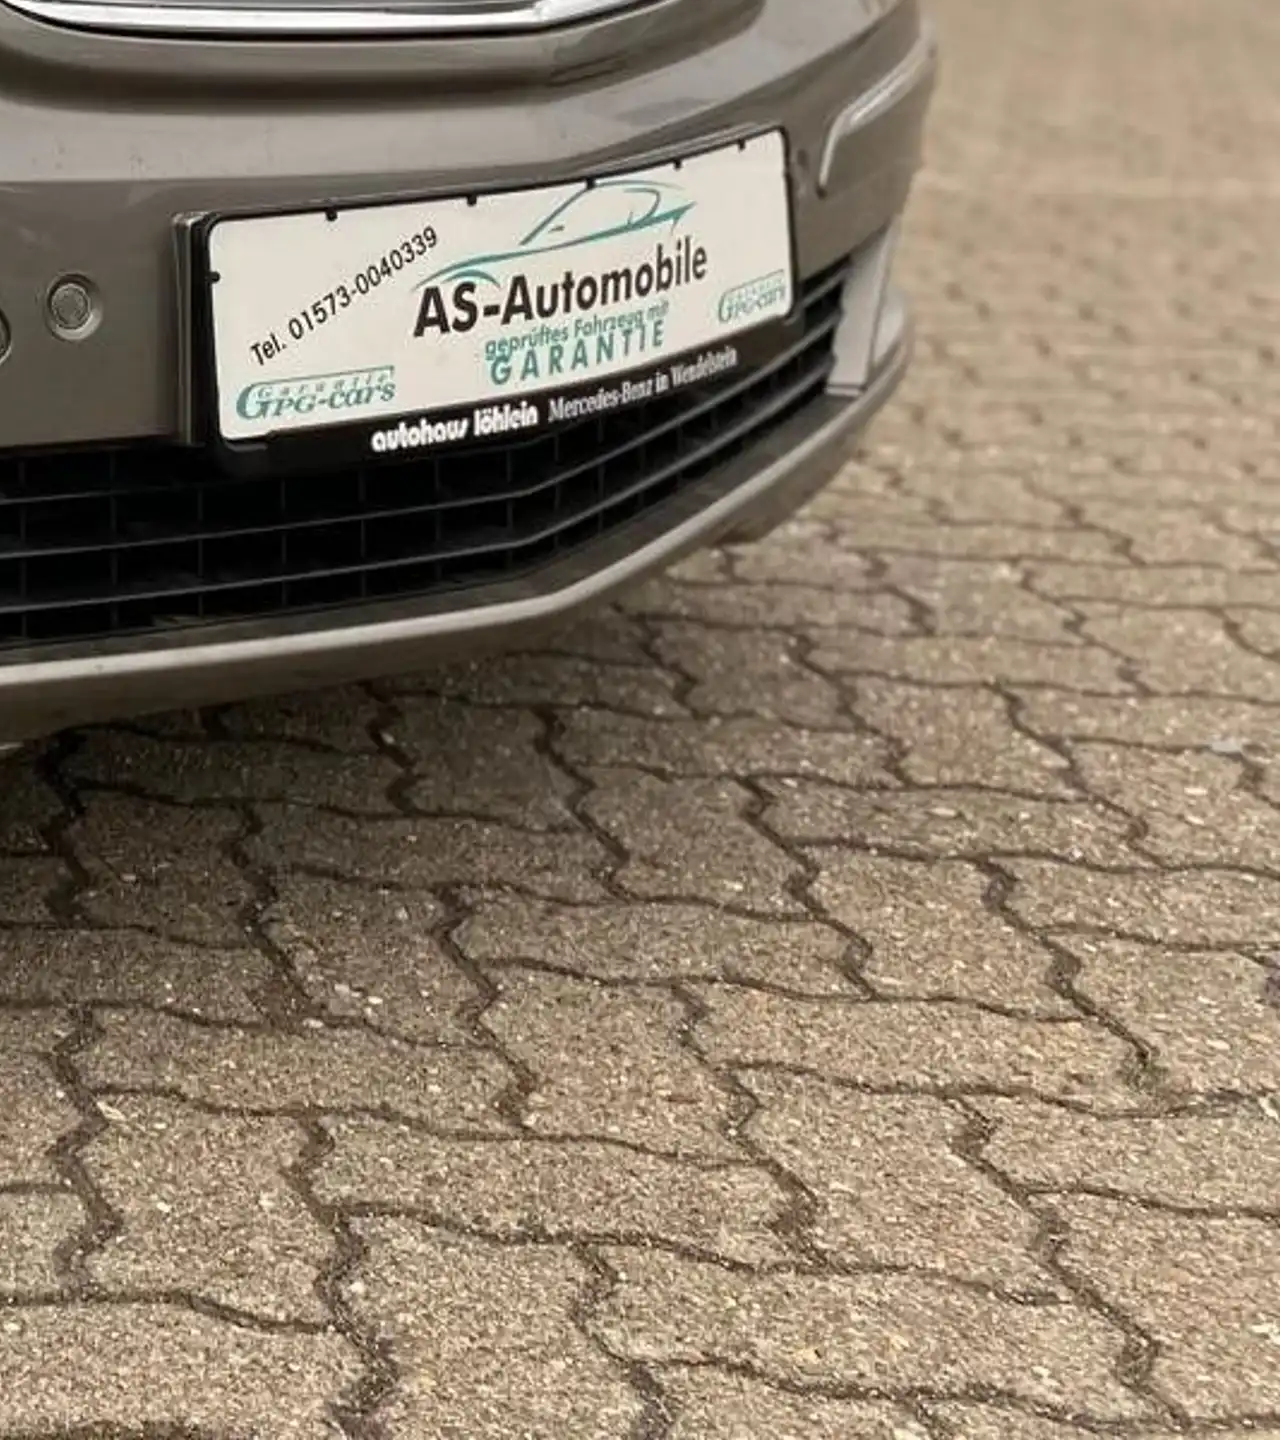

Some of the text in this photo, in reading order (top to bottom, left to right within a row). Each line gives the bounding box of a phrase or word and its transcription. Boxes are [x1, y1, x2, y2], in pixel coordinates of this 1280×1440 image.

[250, 225, 438, 366] Tel. 01573-0040339
[413, 234, 708, 338] AS-Automobile
[484, 323, 569, 361] geprüftes
[573, 309, 646, 339] Fahrzeug
[490, 319, 664, 385] GARANTIE
[371, 415, 470, 452] autohaus
[473, 400, 539, 437] löhlein
[547, 380, 653, 423] Mercedes-Benz
[655, 371, 670, 394] in
